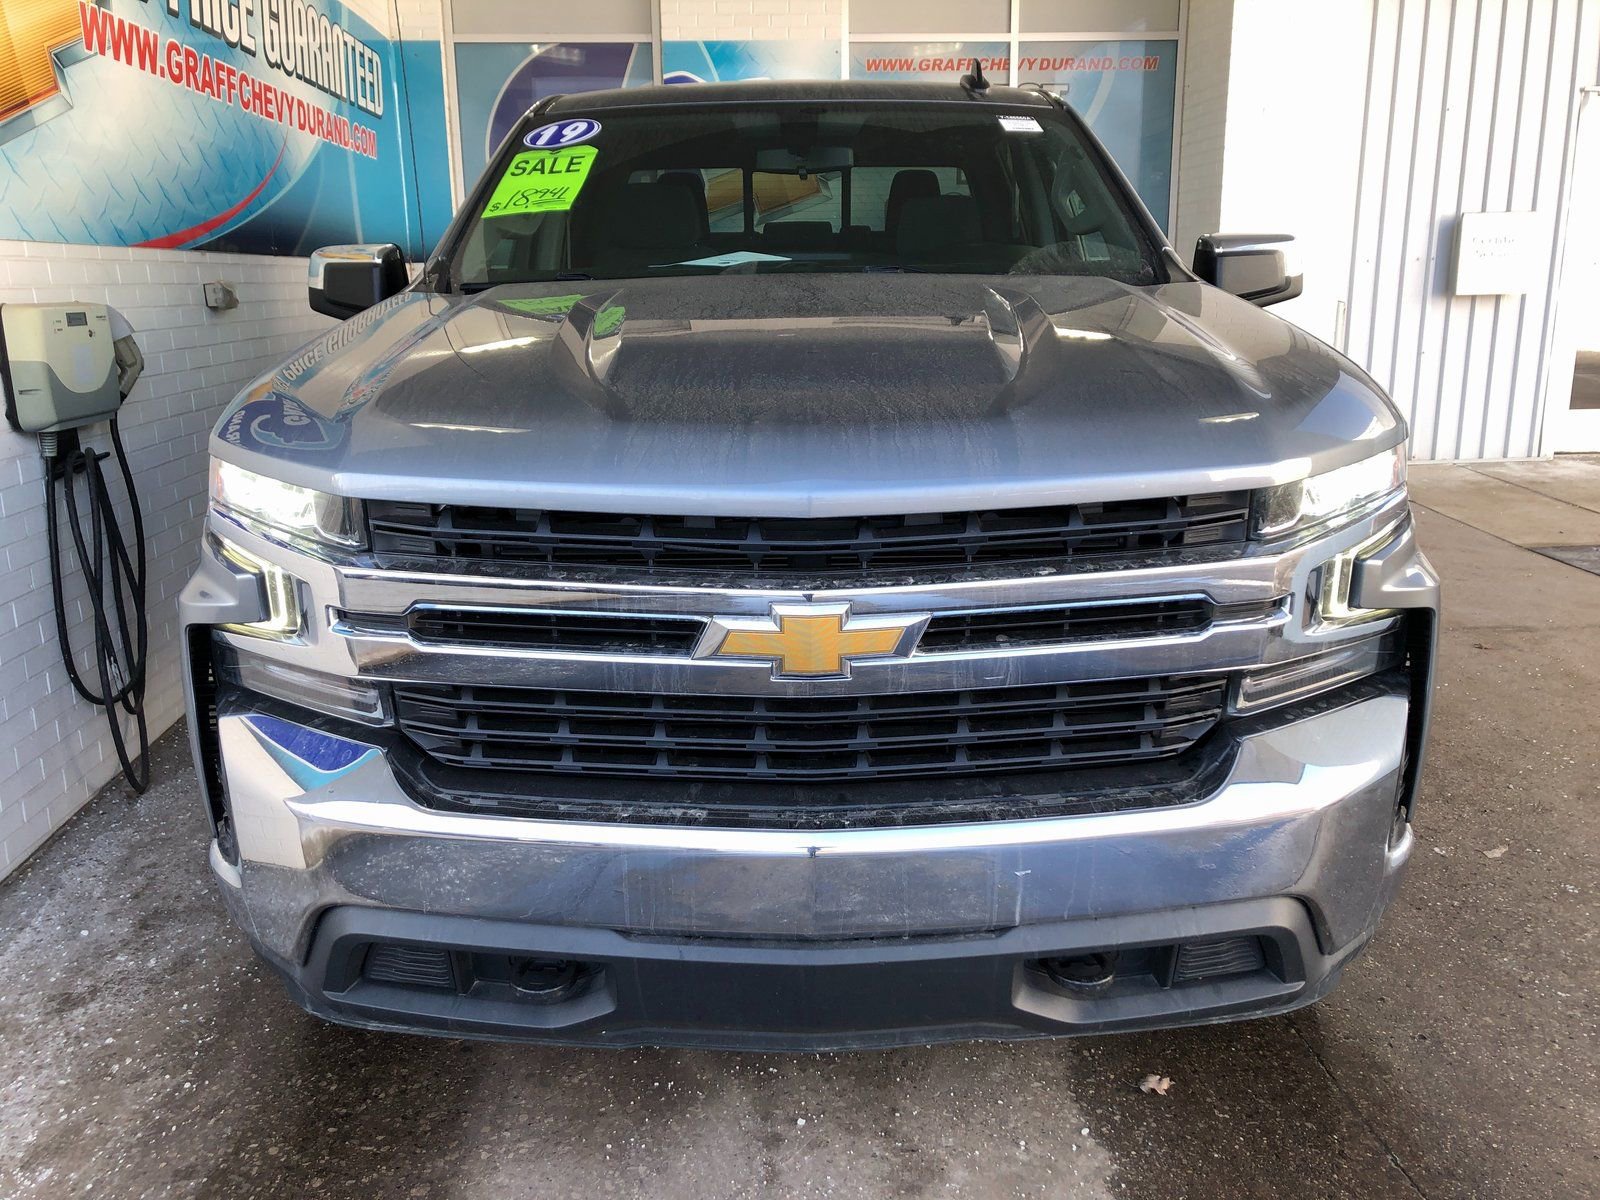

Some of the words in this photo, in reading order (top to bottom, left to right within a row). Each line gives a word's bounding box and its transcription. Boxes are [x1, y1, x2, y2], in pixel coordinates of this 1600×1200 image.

[261, 0, 384, 119] GUARANTEED
[535, 121, 588, 145] 19
[511, 156, 585, 176] SALE
